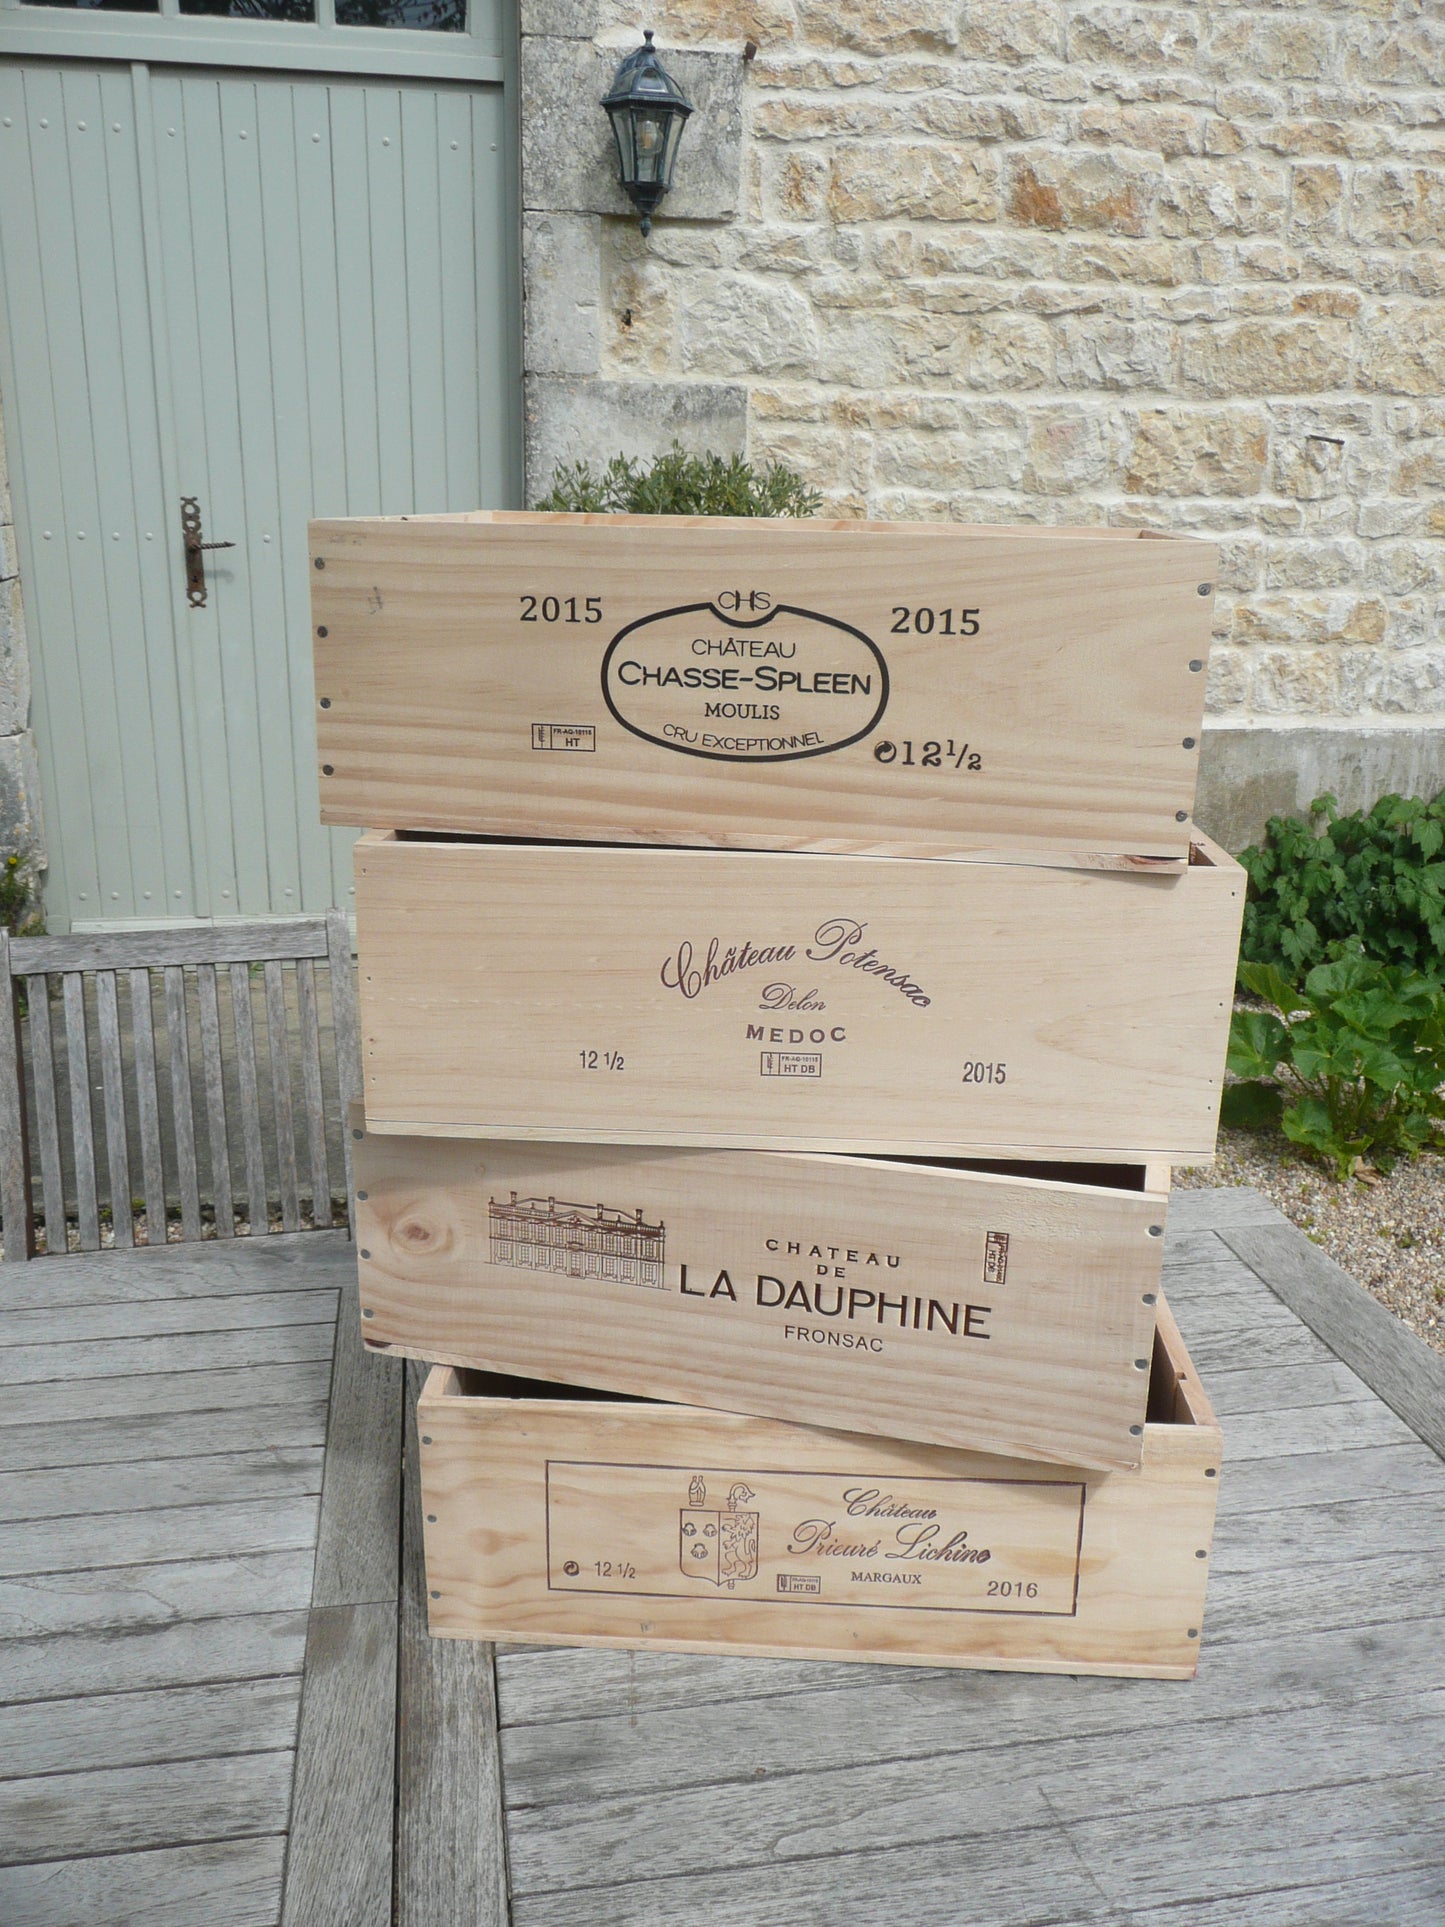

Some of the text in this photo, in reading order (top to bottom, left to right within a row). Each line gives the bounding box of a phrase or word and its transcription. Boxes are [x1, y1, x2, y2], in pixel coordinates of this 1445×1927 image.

[519, 595, 603, 623] 2015
[717, 590, 771, 612] CHS
[890, 606, 980, 636] 2015
[691, 637, 796, 659] CHÂTEAU
[617, 660, 871, 695] CHASSE-SPLEEN
[703, 702, 780, 721] MOULIS
[565, 737, 580, 747] HT
[662, 723, 825, 751] CRU EXCEPTIONNEL
[660, 918, 932, 1008] Château Potensac
[758, 982, 827, 1012] Delon
[746, 1023, 847, 1045] MEDOC
[784, 1064, 816, 1074] HT DB
[962, 1061, 1007, 1085] 2015
[764, 1238, 901, 1269] CHATEAU
[816, 1263, 846, 1278] DE
[679, 1263, 992, 1340] LA DAUPHINE
[784, 1325, 884, 1352] FRONSAC
[842, 1487, 938, 1520] Château
[786, 1518, 992, 1565] Prieuré Lichine
[850, 1570, 922, 1586] MARGAUX
[986, 1579, 1039, 1599] 2016
